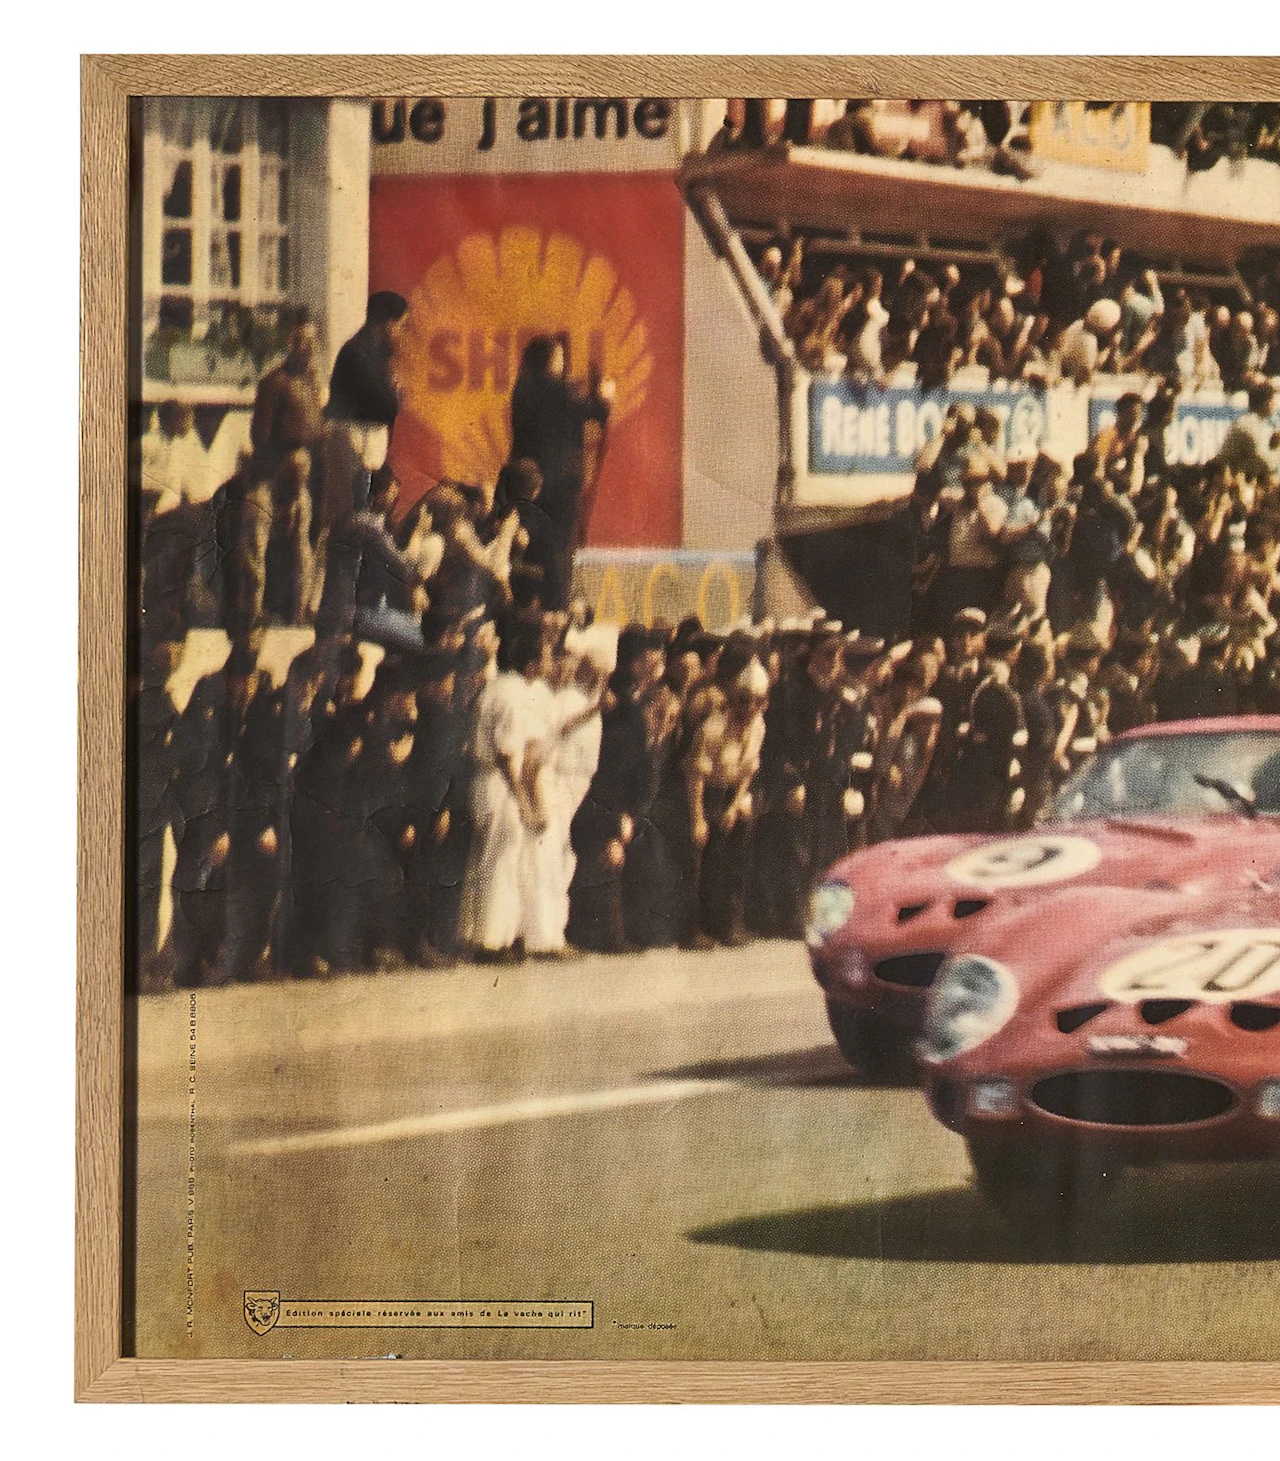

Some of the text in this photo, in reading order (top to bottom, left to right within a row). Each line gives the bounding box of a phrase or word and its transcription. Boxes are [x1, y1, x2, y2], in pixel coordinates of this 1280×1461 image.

[477, 98, 672, 152] jaime
[189, 1043, 197, 1072] SEINE
[329, 1308, 372, 1319] spéciale
[451, 1309, 474, 1317] amis
[480, 1309, 492, 1317] de
[513, 1309, 543, 1317] vache
[547, 1309, 564, 1318] qui
